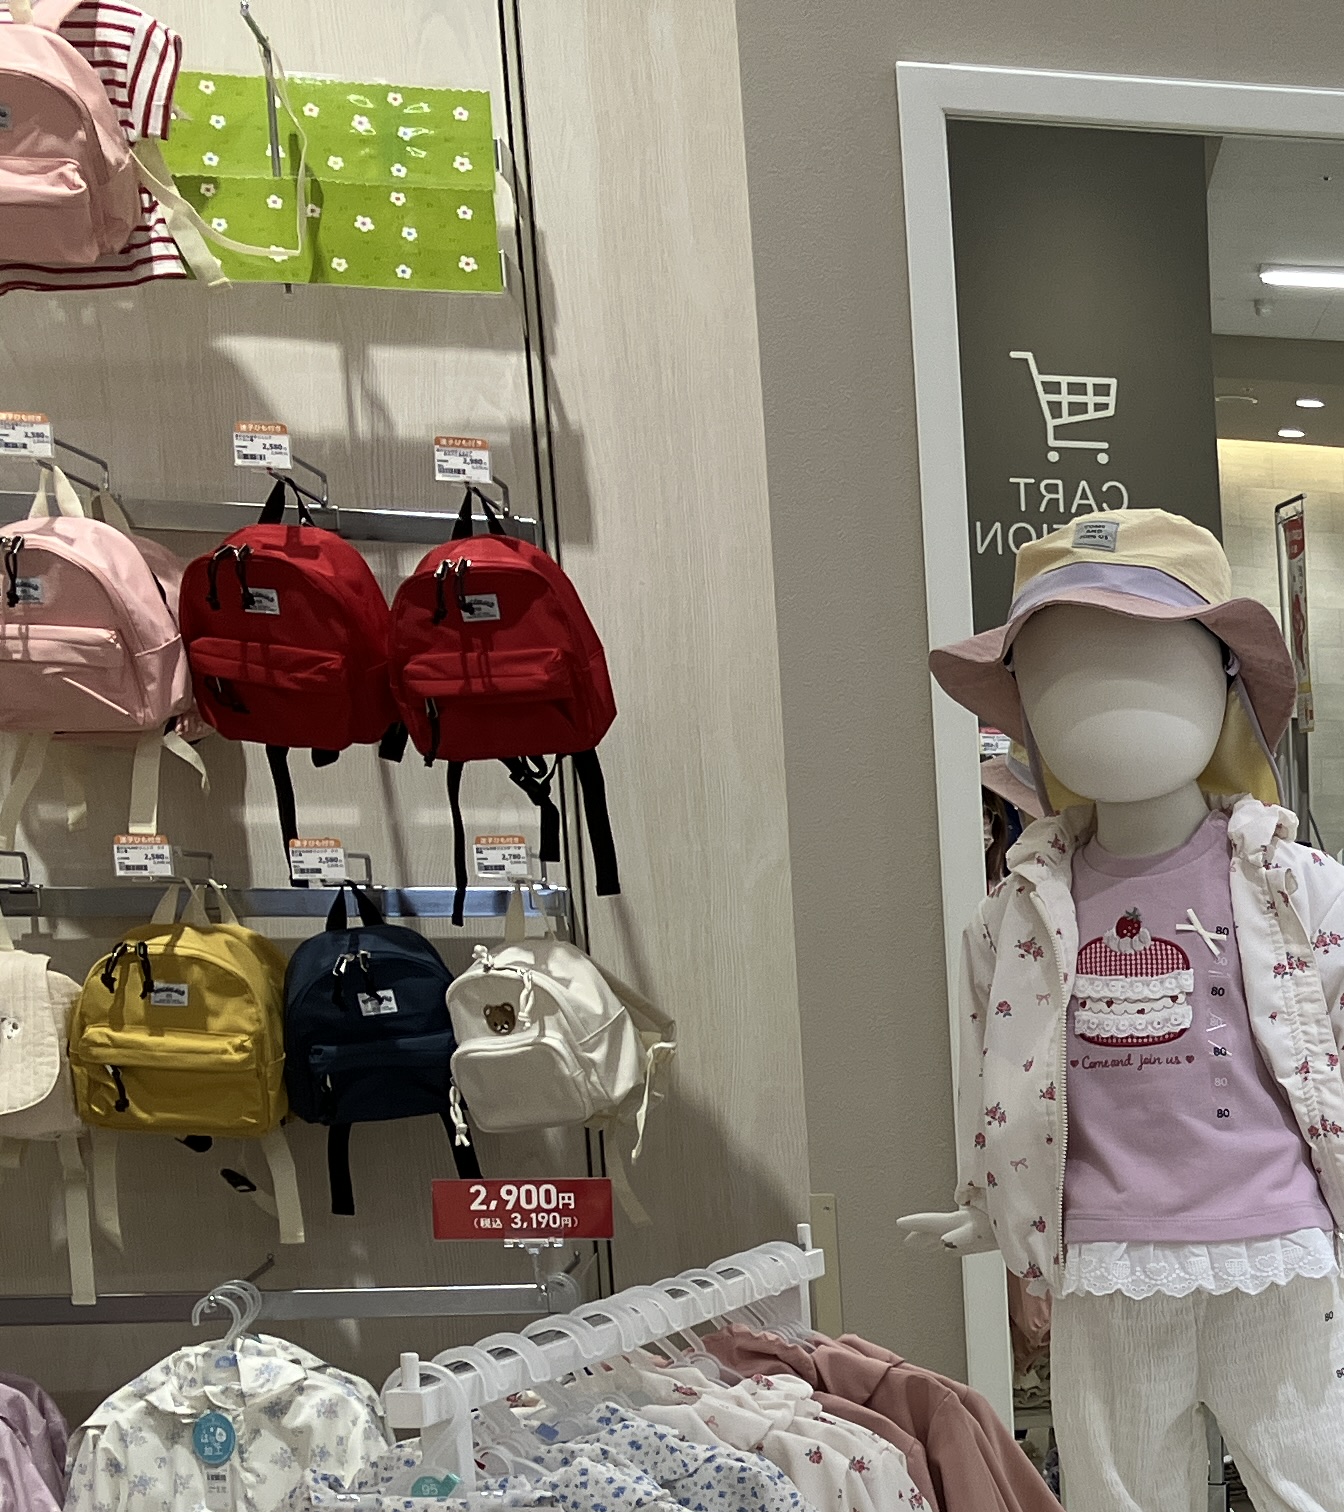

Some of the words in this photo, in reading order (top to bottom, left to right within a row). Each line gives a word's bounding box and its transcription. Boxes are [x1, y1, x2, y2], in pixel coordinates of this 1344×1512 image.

[1215, 926, 1230, 936] 80
[1210, 986, 1225, 997] 80
[1216, 1108, 1230, 1118] 80
[469, 1184, 575, 1210] 2,900円
